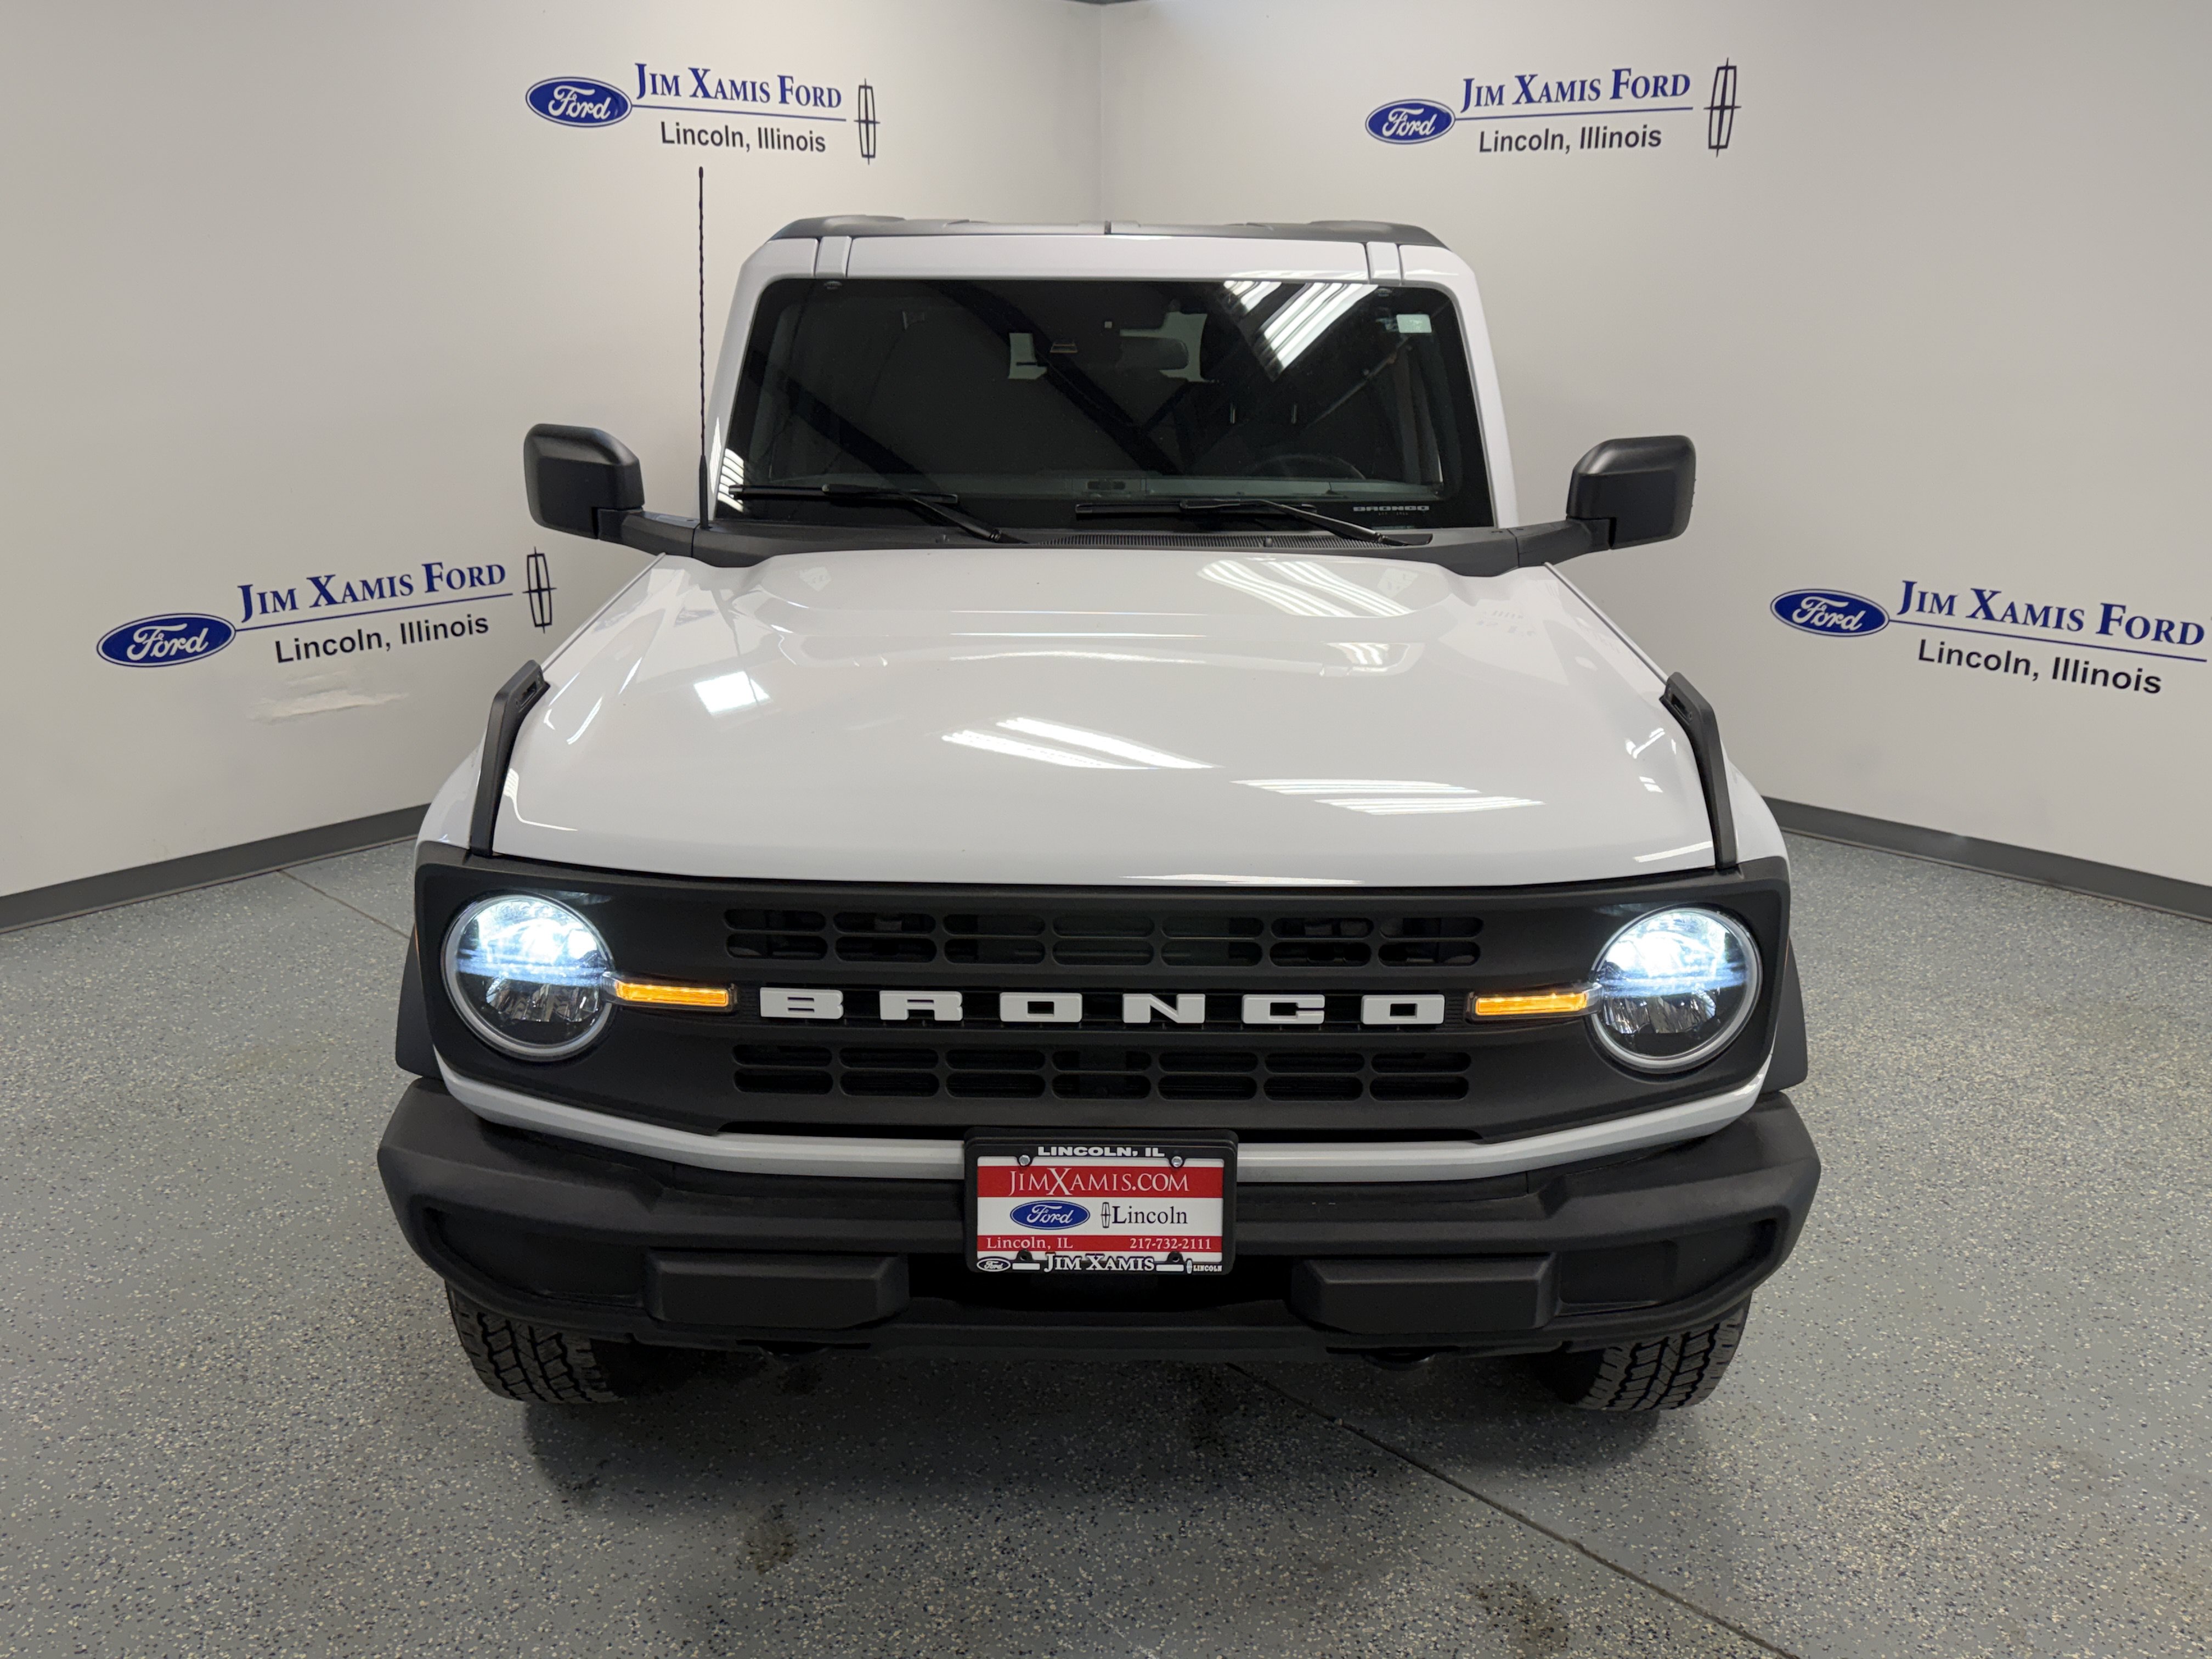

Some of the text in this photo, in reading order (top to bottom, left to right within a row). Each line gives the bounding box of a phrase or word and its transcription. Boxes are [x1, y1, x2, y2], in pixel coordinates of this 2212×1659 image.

[635, 63, 842, 108] JIM XAMIS FORD
[1460, 67, 1690, 112] JIM XAMIS FORD
[548, 85, 611, 120] Ford
[661, 121, 826, 153] Lincoln, Illinois
[1382, 108, 1436, 137] Ford
[1479, 125, 1662, 154] Lincoln, Illinois
[237, 562, 506, 623] JIM XAMIS FORD
[1792, 596, 1864, 631] Ford
[1897, 580, 2205, 646] JIM XAMIS FORD
[126, 623, 208, 661] Ford
[275, 613, 489, 663] Lincoln, Illinois
[1918, 638, 2163, 694] Lincoln, Illinois
[760, 987, 1446, 1024] BRONCO
[1037, 1146, 1165, 1157] LINCOLN, IL
[1009, 1167, 1189, 1196] JIMXAMIS.COM
[1027, 1205, 1074, 1224] Ford
[1112, 1206, 1188, 1224] Lincoln
[987, 1237, 1073, 1250] Lincoln, IL
[1130, 1238, 1211, 1250] 217-732-2111
[984, 1260, 1003, 1269] Ford
[1043, 1253, 1155, 1272] JIM XAMIS
